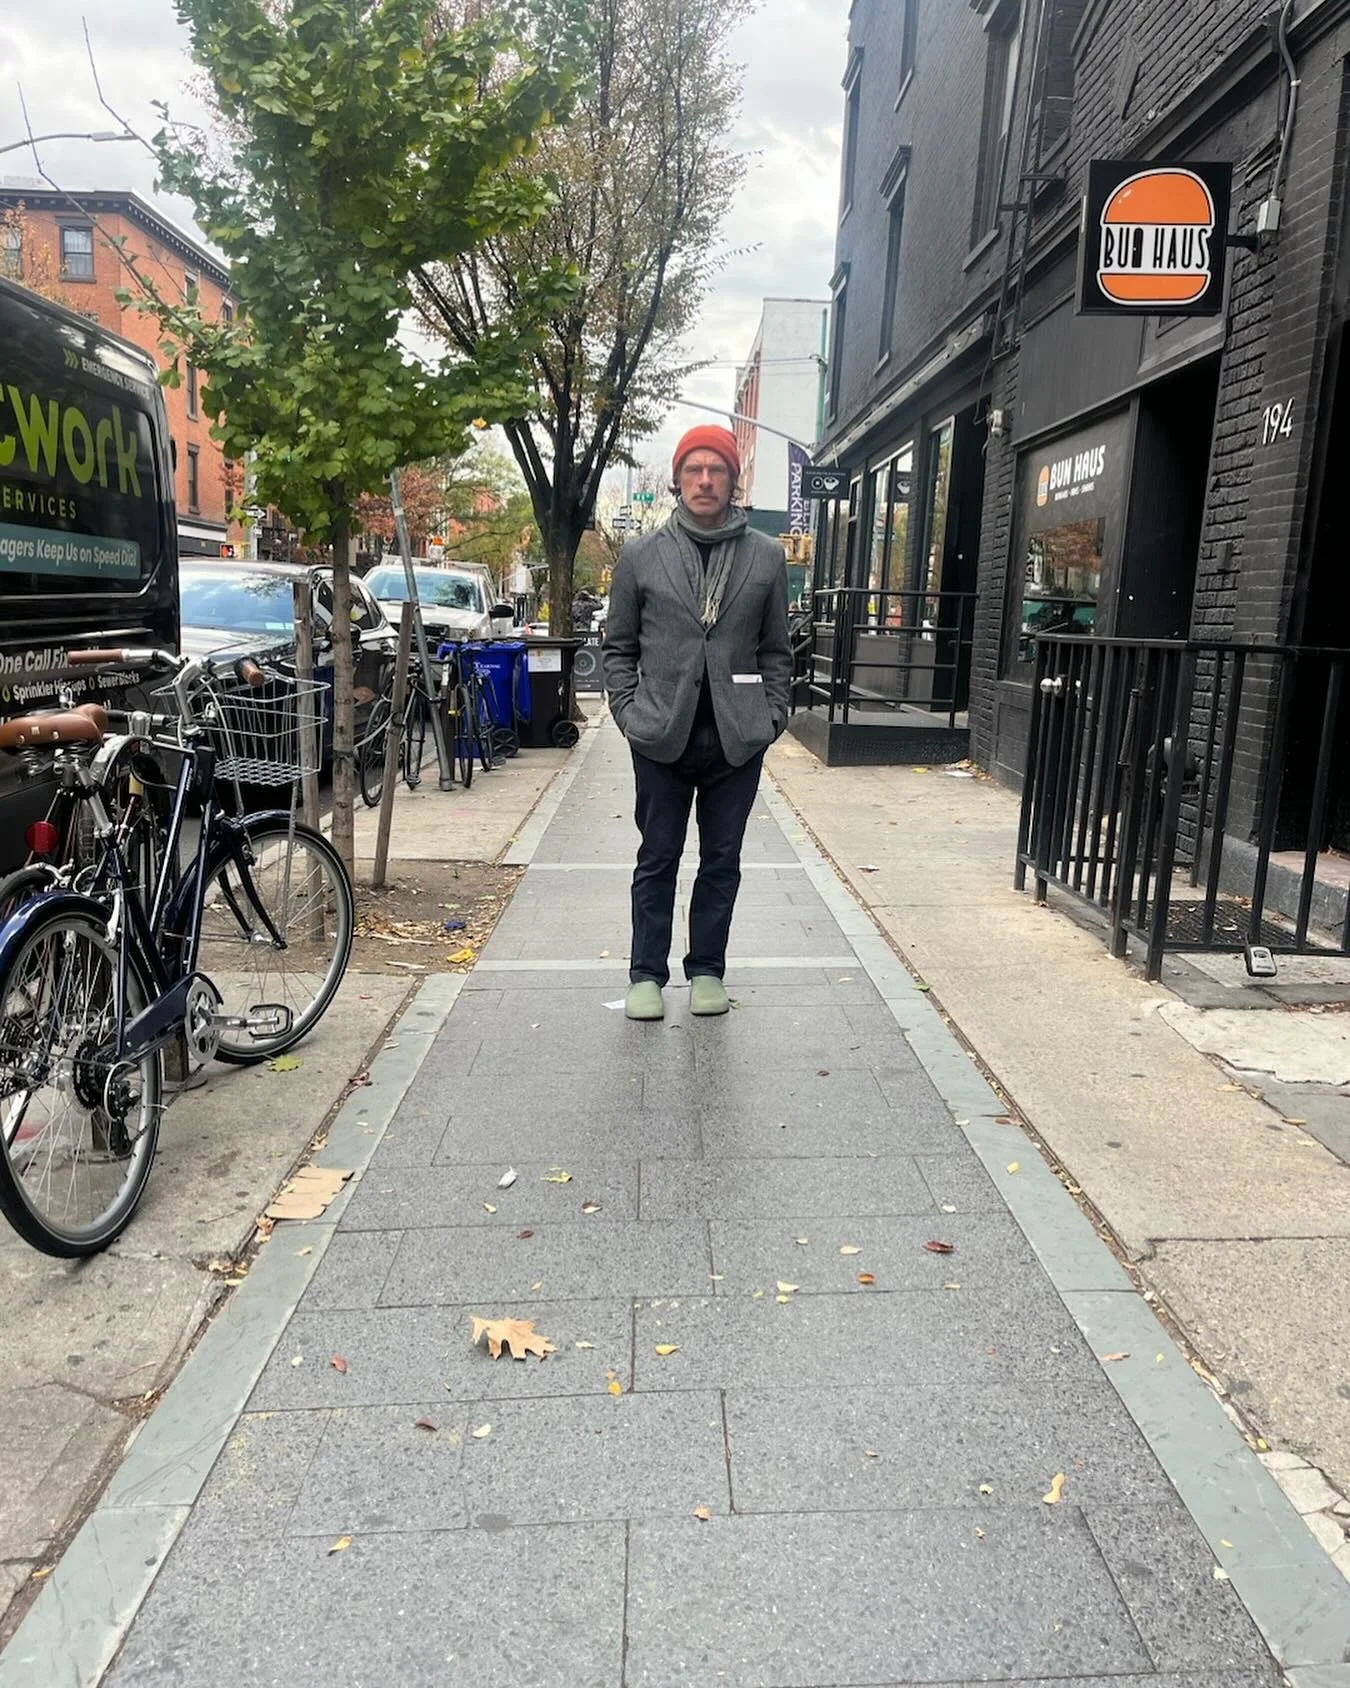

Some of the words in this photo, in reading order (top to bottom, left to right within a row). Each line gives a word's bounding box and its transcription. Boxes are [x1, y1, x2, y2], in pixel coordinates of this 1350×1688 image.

[1152, 227, 1208, 269] HAUS
[81, 356, 125, 388] EMERGENCY
[1262, 396, 1295, 445] 194
[1049, 456, 1073, 491] BUN
[1073, 443, 1106, 483] HAUS
[2, 485, 77, 519] ERVICES
[790, 462, 803, 537] PARKING
[0, 539, 35, 562] agers
[37, 540, 63, 567] Keep
[66, 543, 79, 561] Us
[80, 547, 92, 562] on
[93, 546, 120, 569] Speed
[121, 549, 137, 567] Dial
[25, 648, 51, 672] Call
[13, 680, 54, 704] Sprinkler
[97, 674, 120, 689] Sewer
